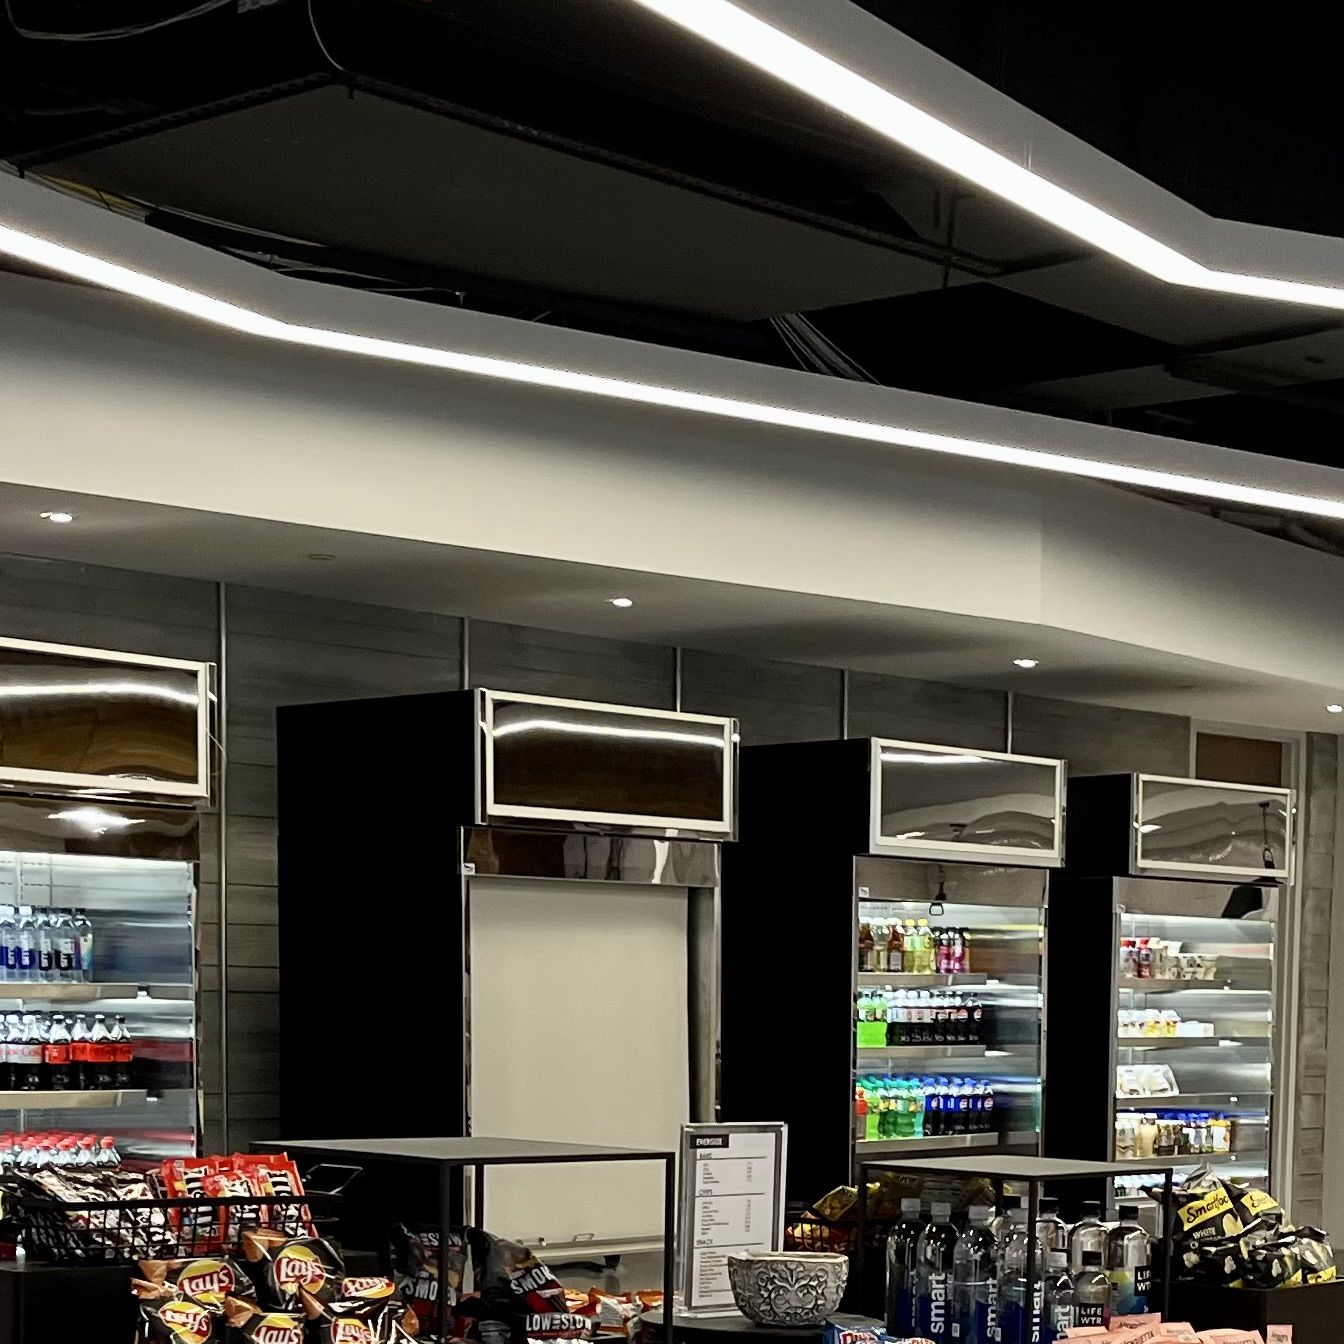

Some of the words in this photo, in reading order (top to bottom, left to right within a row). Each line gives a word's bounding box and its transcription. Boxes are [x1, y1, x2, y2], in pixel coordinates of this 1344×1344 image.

[1137, 1270, 1151, 1280] LIF
[1137, 1281, 1151, 1291] WT
[928, 1272, 946, 1334] smart
[1080, 1306, 1102, 1316] LIFE
[525, 1314, 551, 1331] LOW
[1056, 1304, 1070, 1340] art
[1080, 1317, 1102, 1325] WTR
